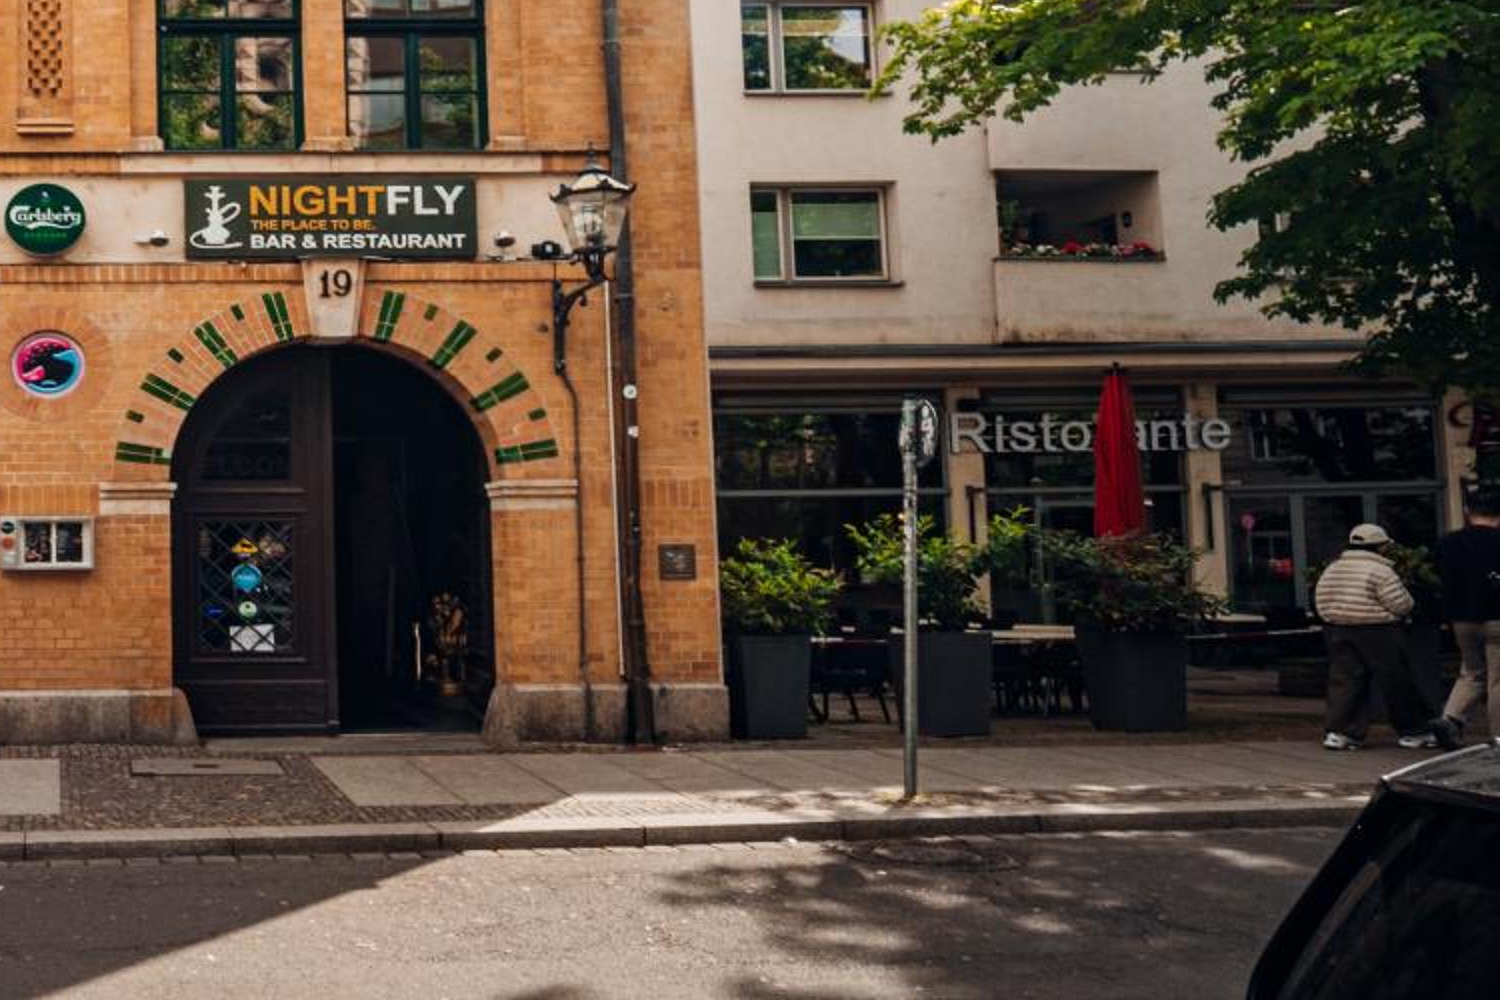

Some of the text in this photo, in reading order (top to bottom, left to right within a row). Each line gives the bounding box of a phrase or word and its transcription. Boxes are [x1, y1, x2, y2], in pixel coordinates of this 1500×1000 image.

[250, 185, 465, 216] NIGHTFLY
[10, 205, 81, 229] Carlsberg
[251, 219, 376, 230] THE PLACE TO BE.
[251, 233, 466, 249] BAR & RESTAURANT
[319, 269, 351, 298] 19
[951, 411, 1231, 453] Ristonte
